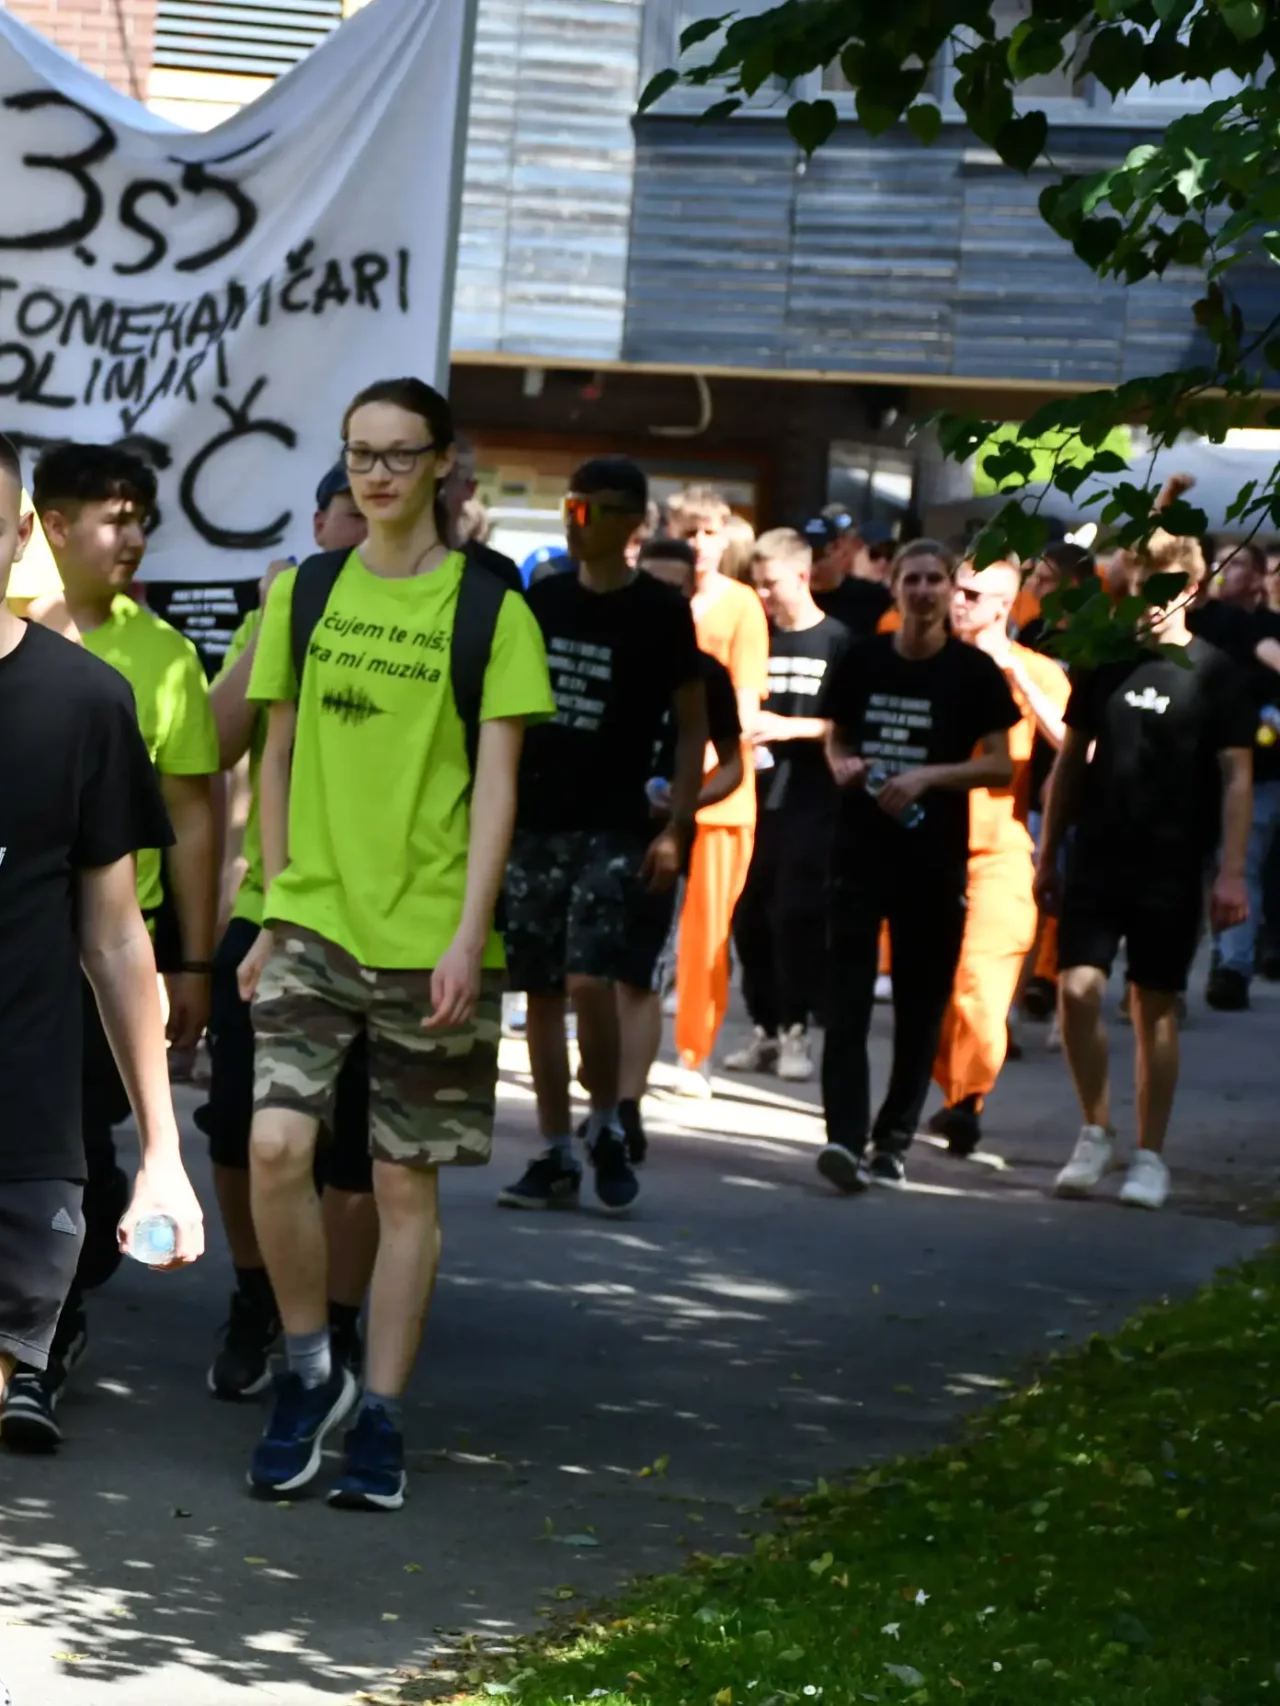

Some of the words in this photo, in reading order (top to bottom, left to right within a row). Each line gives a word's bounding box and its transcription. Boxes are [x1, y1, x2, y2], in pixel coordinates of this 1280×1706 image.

[324, 611, 384, 639] čujem
[388, 626, 407, 644] te
[335, 652, 367, 669] mi
[366, 657, 442, 684] muzika
